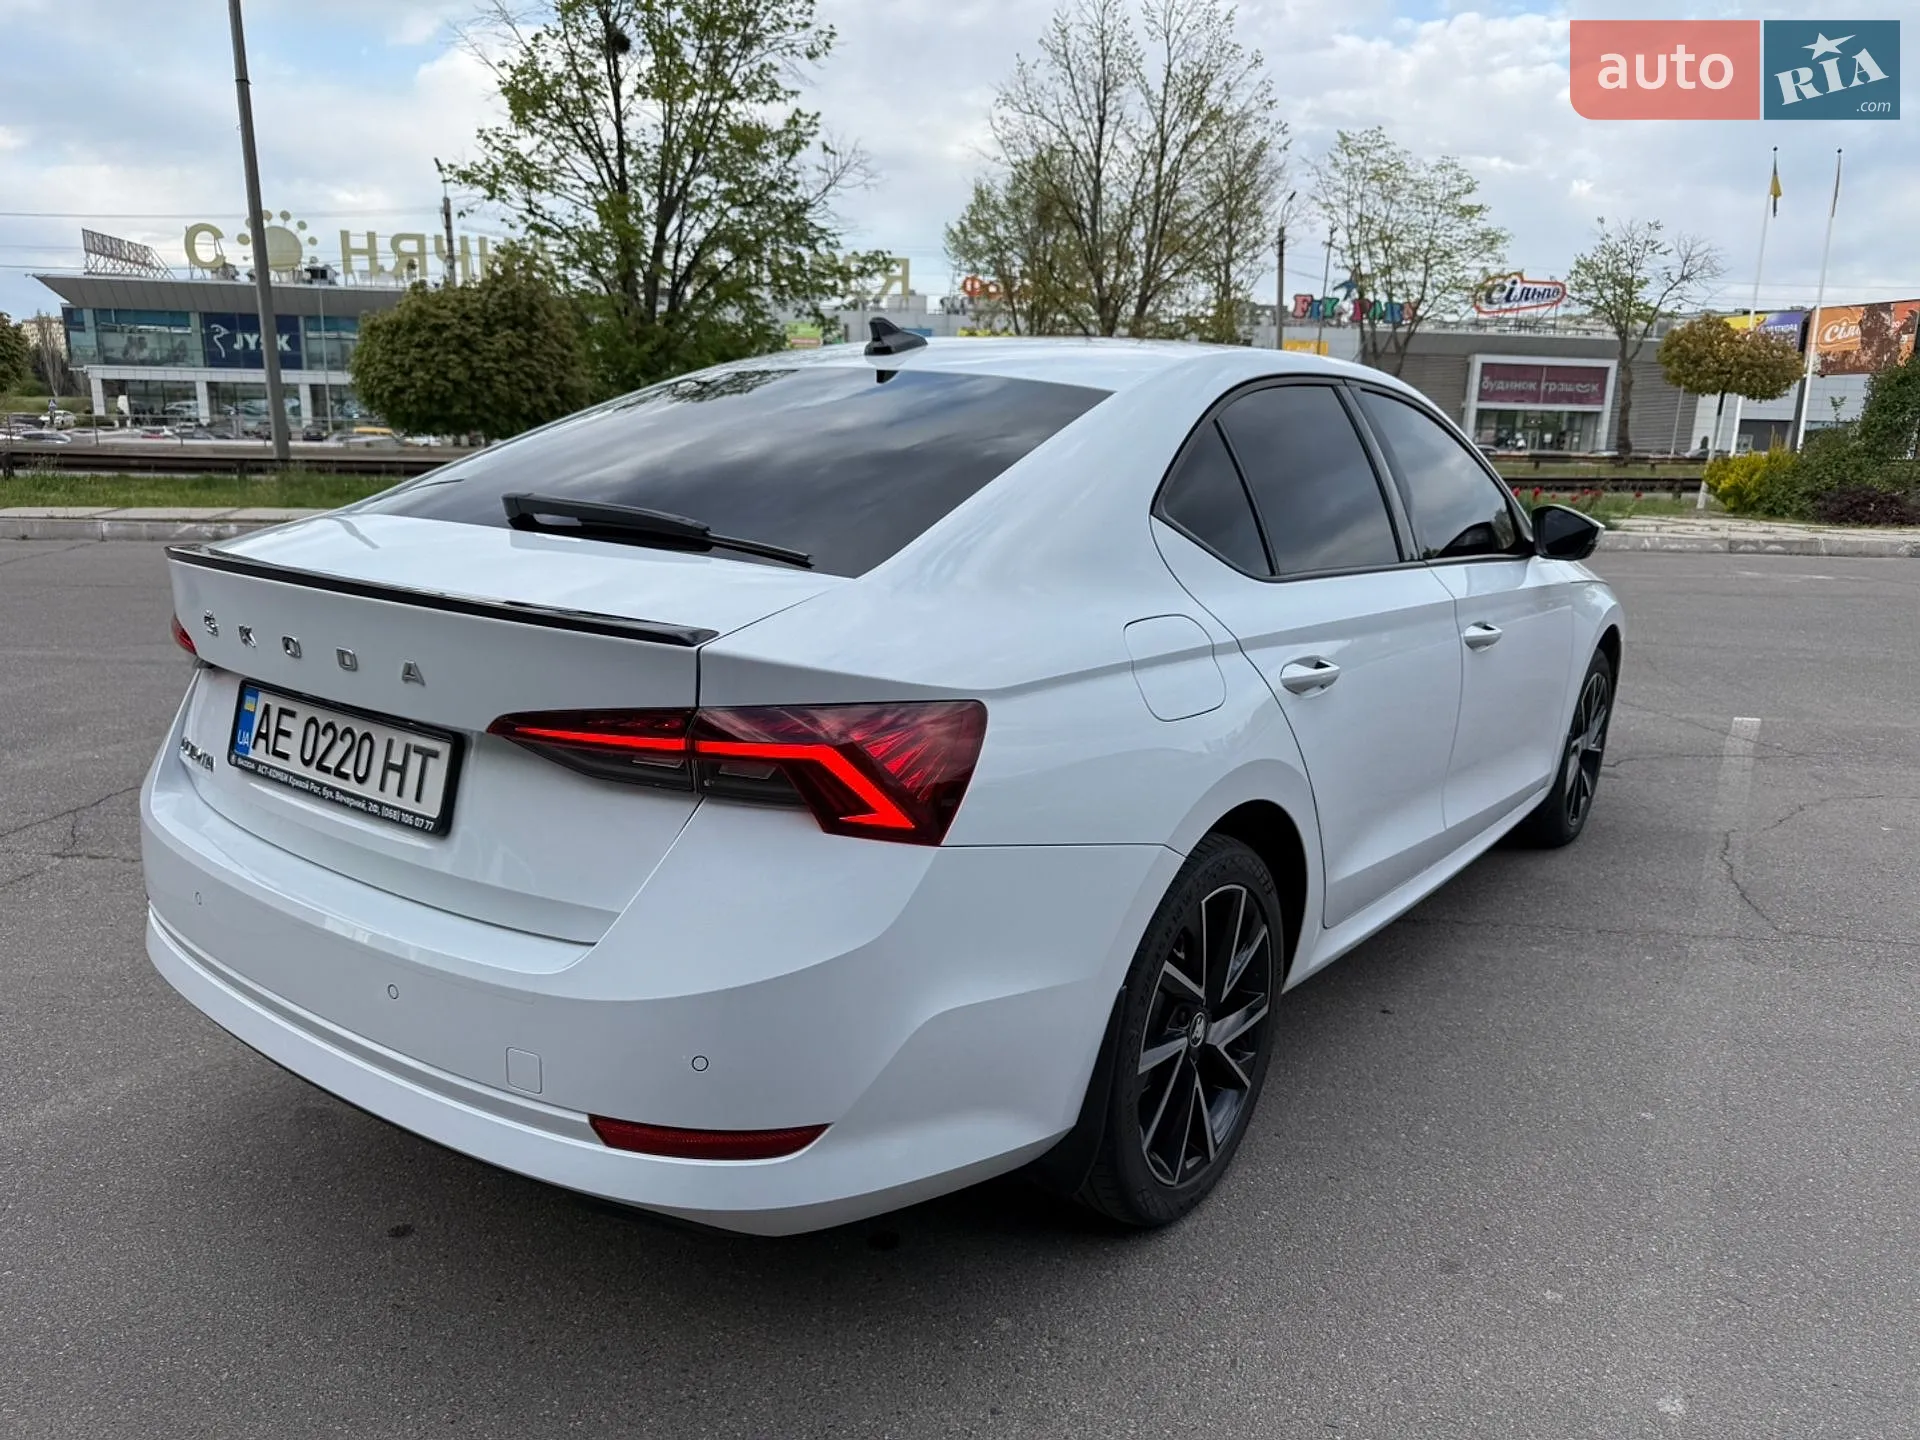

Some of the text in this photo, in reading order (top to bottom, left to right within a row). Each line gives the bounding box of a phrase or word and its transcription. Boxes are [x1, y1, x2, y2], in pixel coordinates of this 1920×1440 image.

[1485, 280, 1560, 305] Сільпо
[233, 333, 292, 351] JYK
[1481, 376, 1537, 393] будинок
[237, 729, 249, 746] UA
[252, 702, 440, 804] AE 0220 HT
